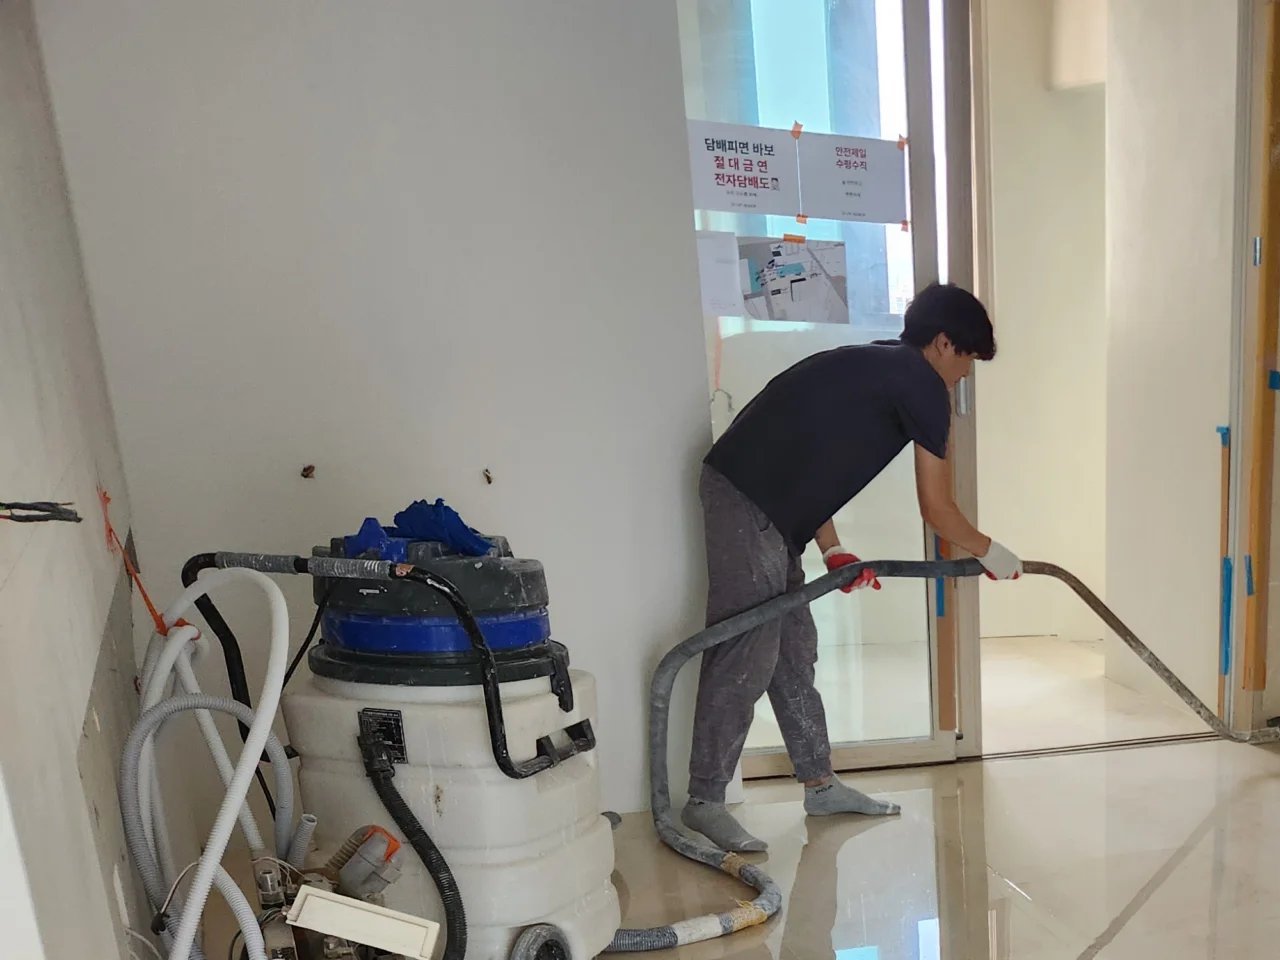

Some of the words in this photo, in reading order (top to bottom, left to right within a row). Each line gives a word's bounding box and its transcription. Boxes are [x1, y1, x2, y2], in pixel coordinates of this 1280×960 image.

[704, 137, 749, 155] 담배피면
[752, 143, 775, 156] 바보
[835, 146, 867, 158] 안전제일
[714, 173, 770, 189] 전자담배도
